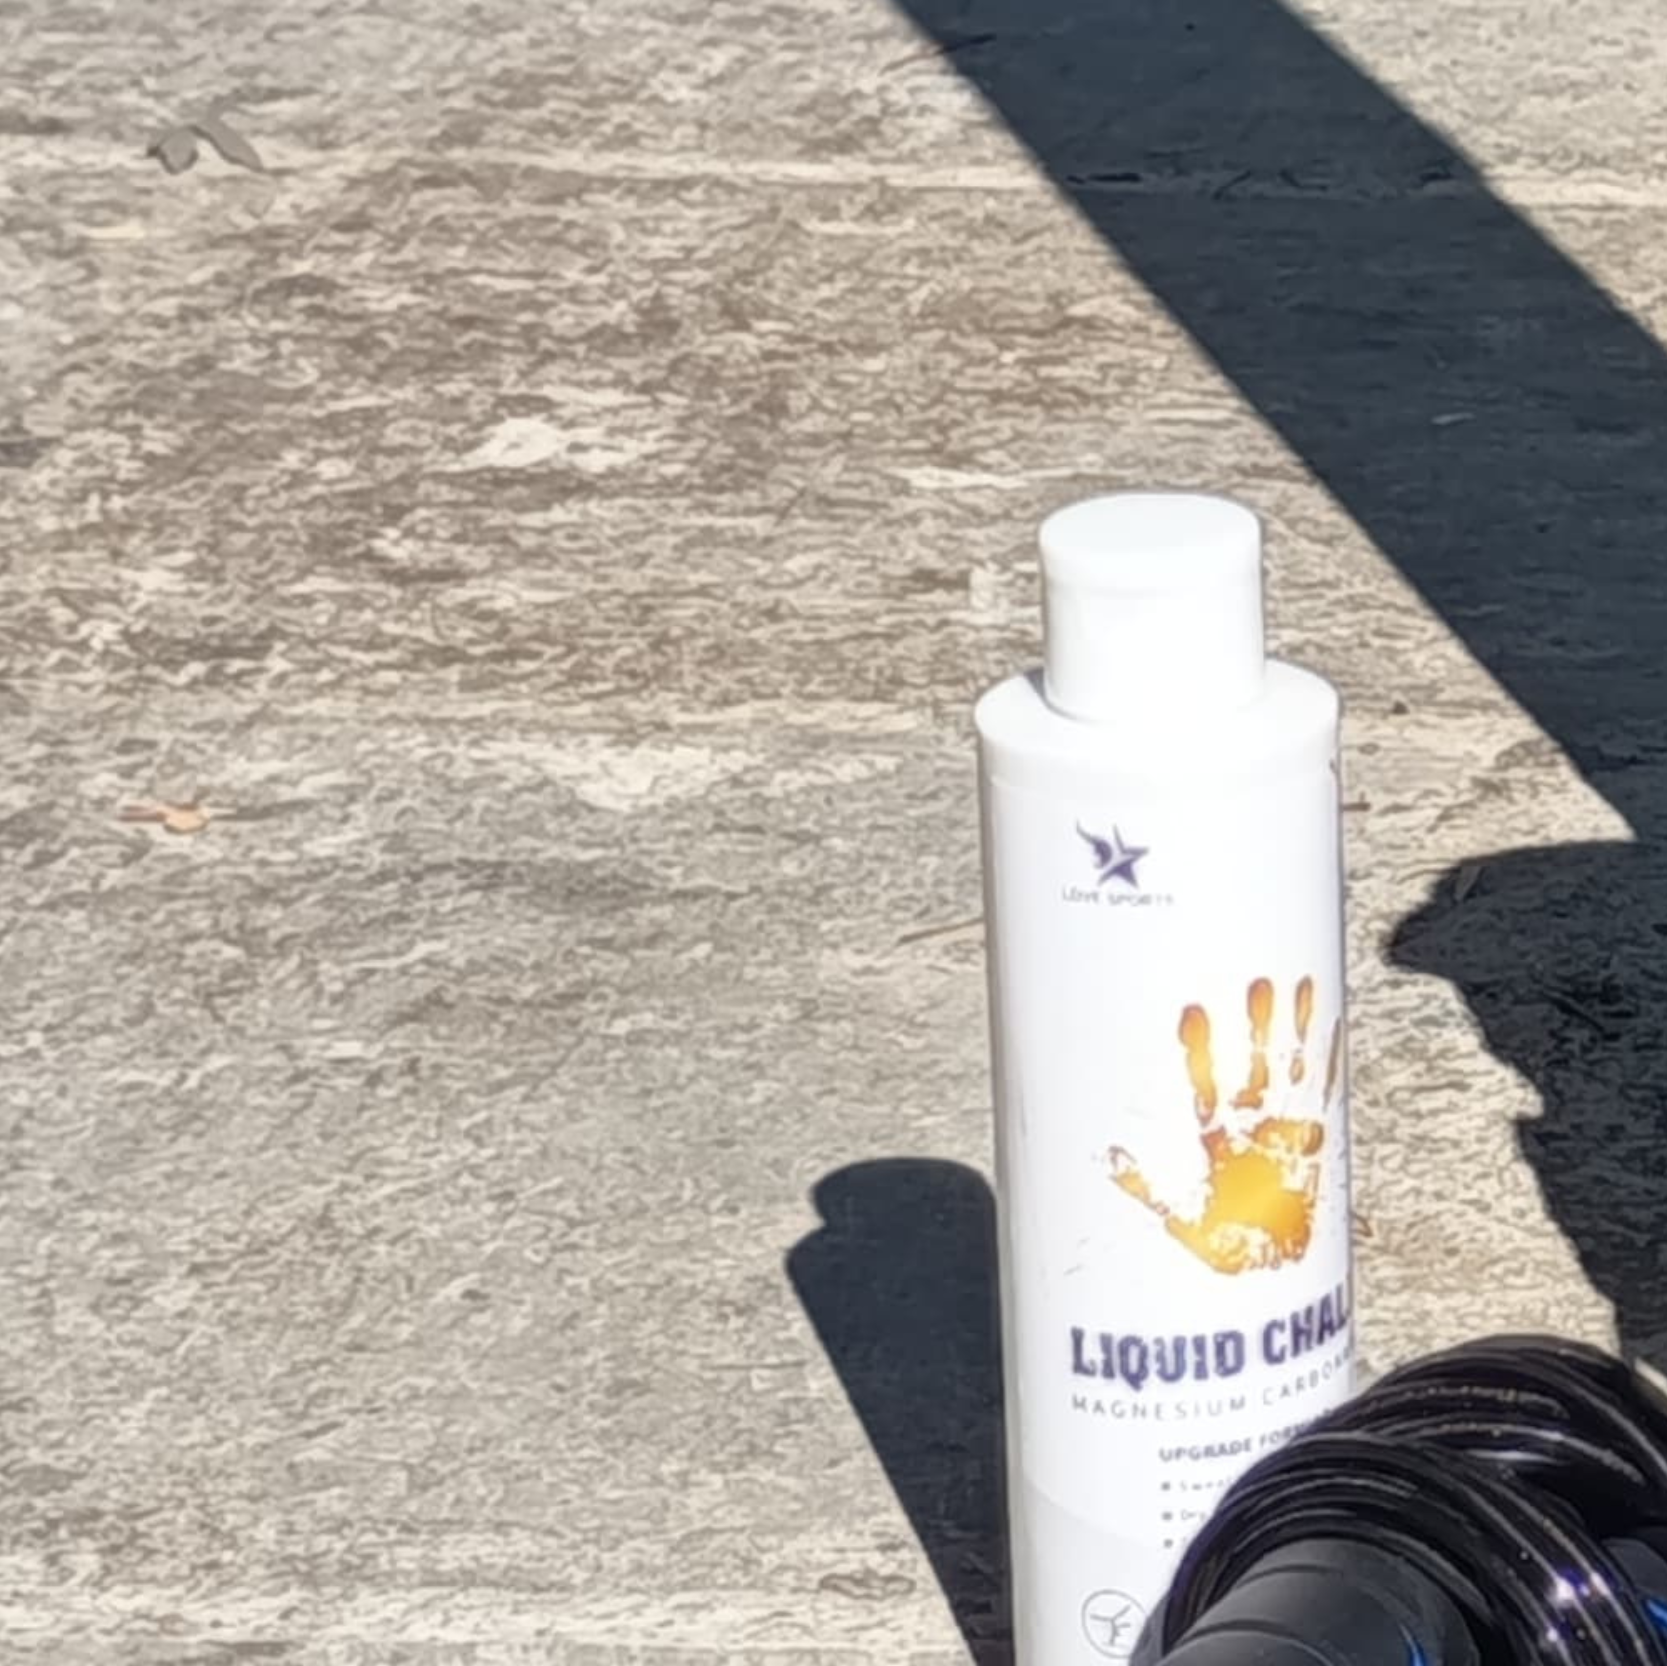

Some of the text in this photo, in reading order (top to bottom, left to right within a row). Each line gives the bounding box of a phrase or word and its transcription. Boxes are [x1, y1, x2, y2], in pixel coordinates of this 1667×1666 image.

[1071, 1282, 1353, 1392] LIQUID CHAL
[1072, 1394, 1246, 1421] MAGNESIUM
[1159, 1437, 1252, 1462] UPGRADE
